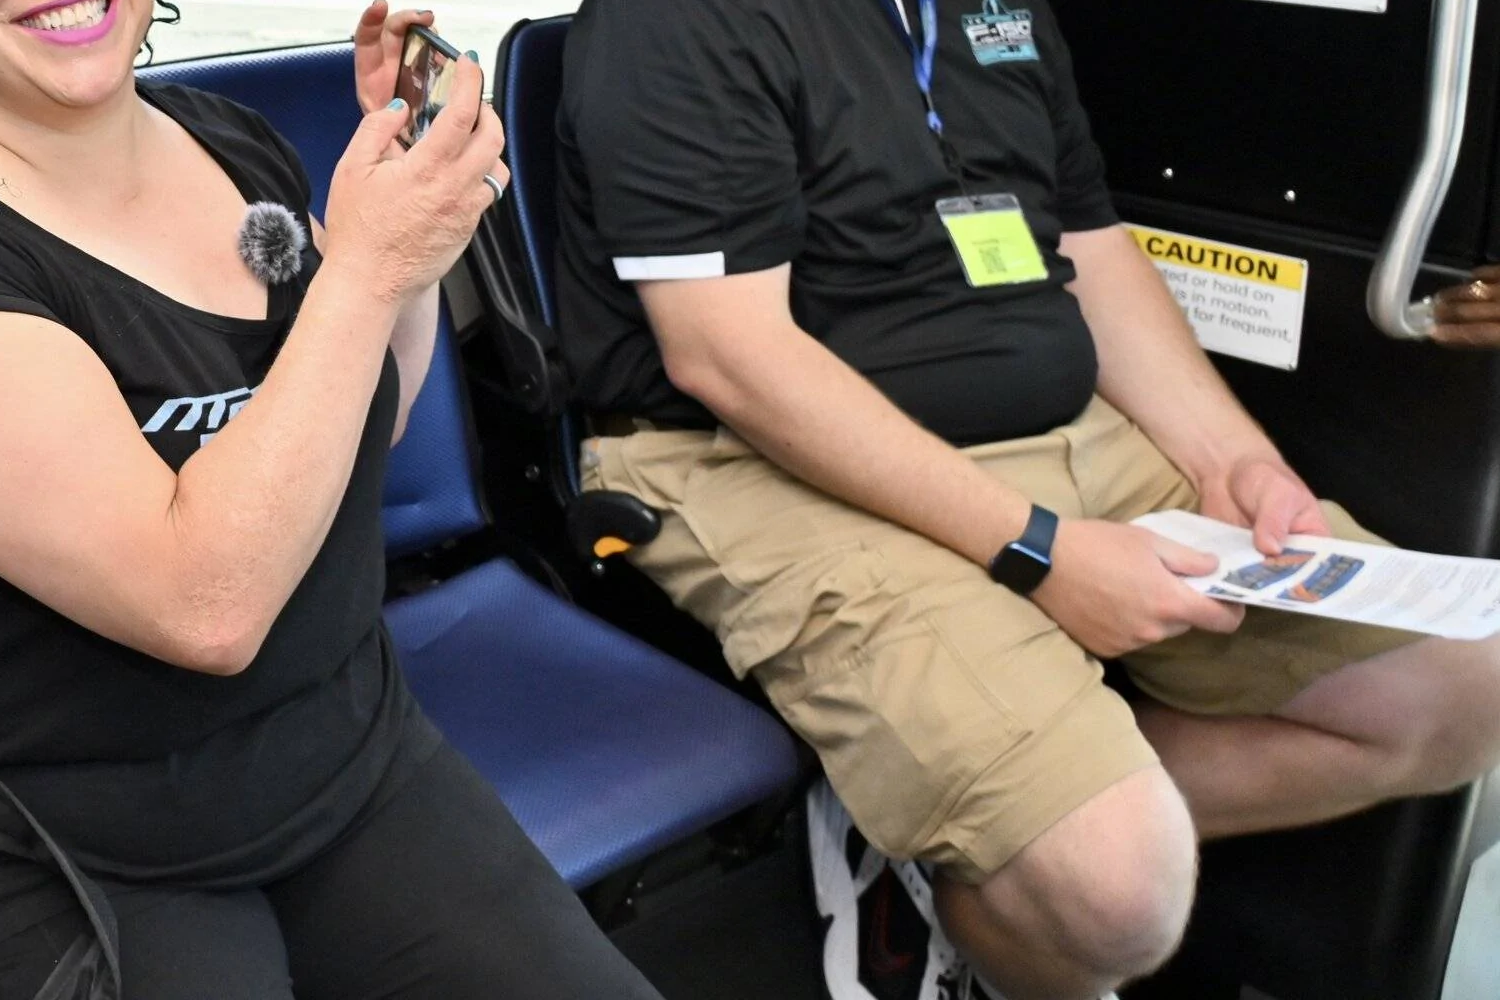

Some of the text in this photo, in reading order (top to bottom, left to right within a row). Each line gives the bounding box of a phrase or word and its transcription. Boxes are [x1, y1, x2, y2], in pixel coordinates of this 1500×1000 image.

[1146, 236, 1278, 281] CAUTION
[1191, 277, 1208, 288] or
[1213, 278, 1249, 298] hold
[1253, 290, 1275, 304] on
[1191, 291, 1206, 303] in
[1194, 307, 1215, 322] for
